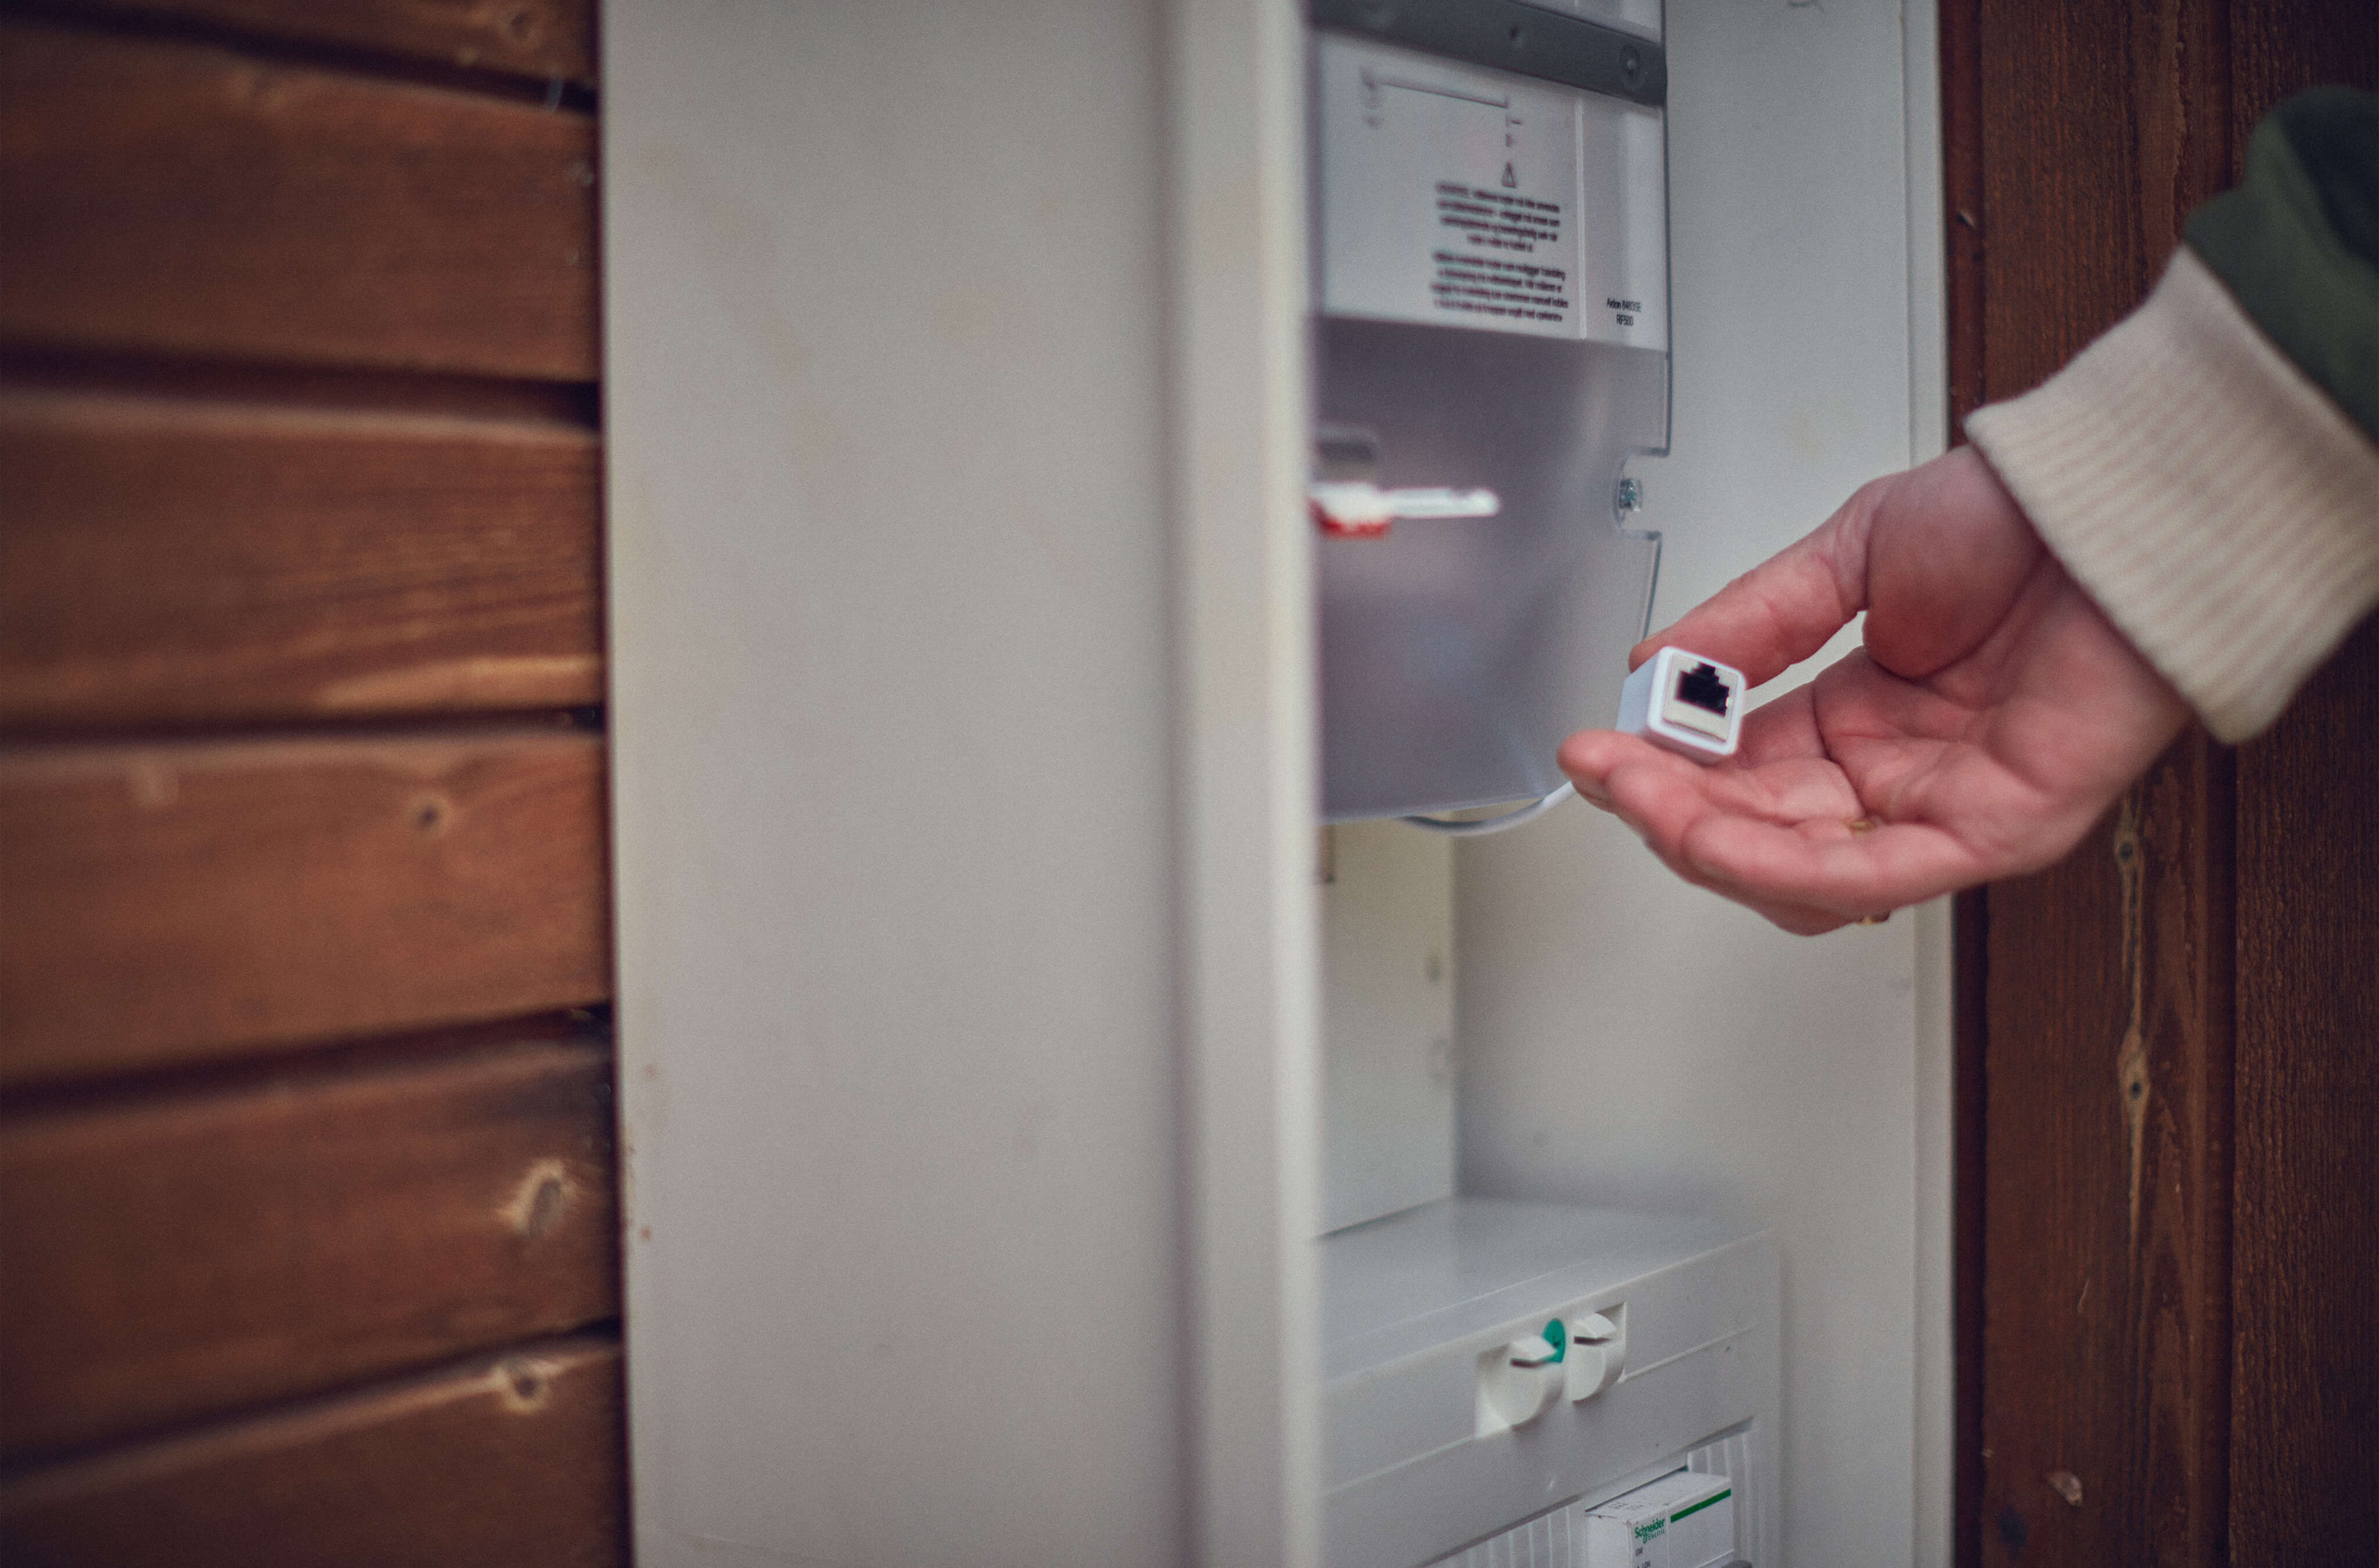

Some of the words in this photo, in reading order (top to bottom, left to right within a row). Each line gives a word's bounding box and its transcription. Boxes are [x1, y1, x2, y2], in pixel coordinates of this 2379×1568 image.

[1607, 297, 1621, 309] Aidon
[1616, 314, 1633, 326] RF500
[1635, 1517, 1665, 1538] Schneider
